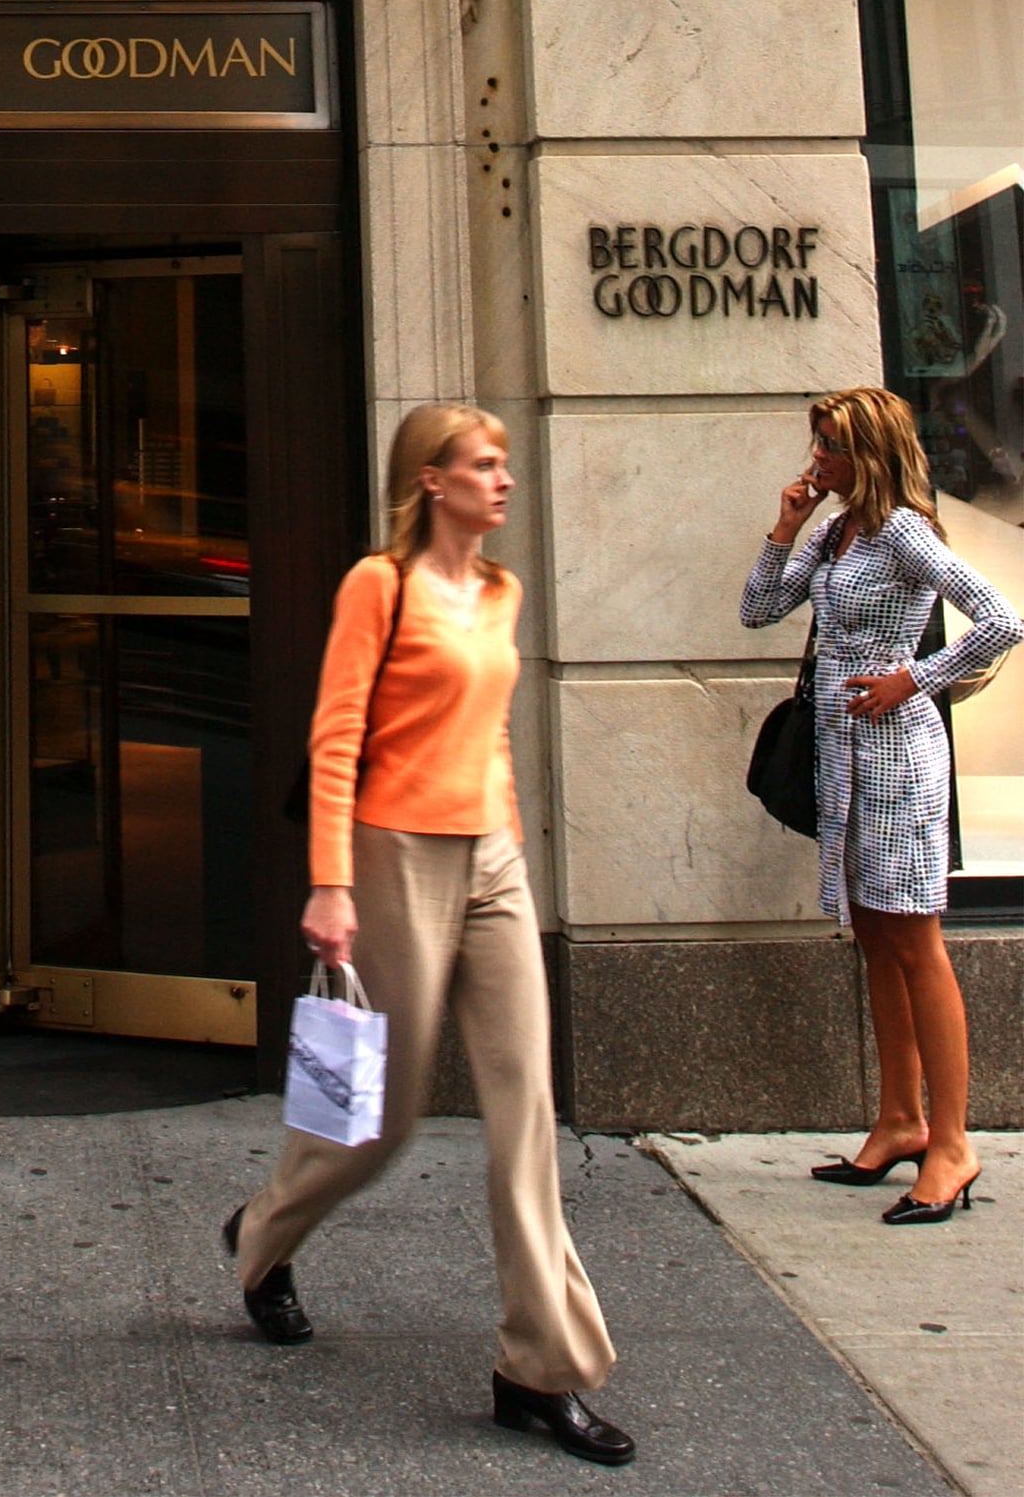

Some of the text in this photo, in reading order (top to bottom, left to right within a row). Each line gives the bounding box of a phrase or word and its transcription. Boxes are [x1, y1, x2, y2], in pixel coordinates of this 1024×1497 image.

[22, 37, 296, 80] GOODMAN
[589, 225, 819, 269] BERGDORF
[593, 273, 818, 319] GOODMAN
